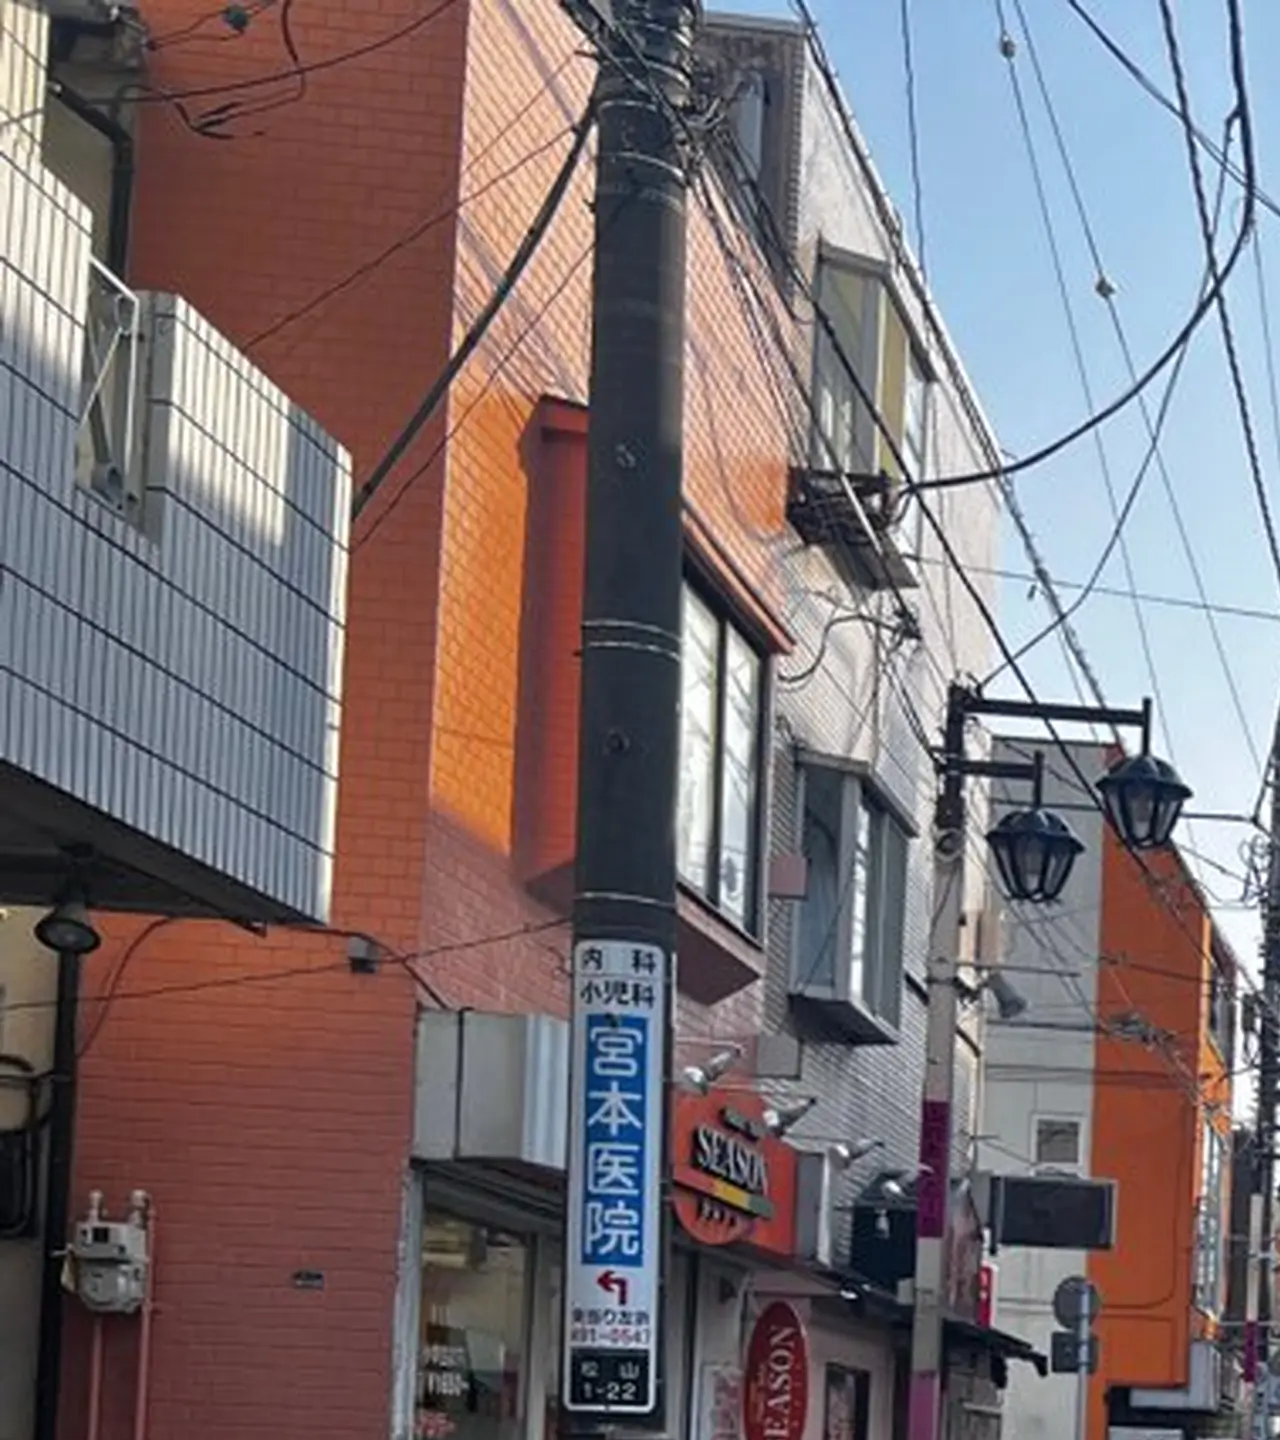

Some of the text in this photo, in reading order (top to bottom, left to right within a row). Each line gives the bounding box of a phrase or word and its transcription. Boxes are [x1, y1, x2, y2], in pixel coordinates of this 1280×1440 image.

[582, 948, 657, 974] 内科
[580, 980, 655, 1008] 小児科
[587, 1026, 645, 1257] 宮本医院
[583, 1381, 637, 1400] 1-22
